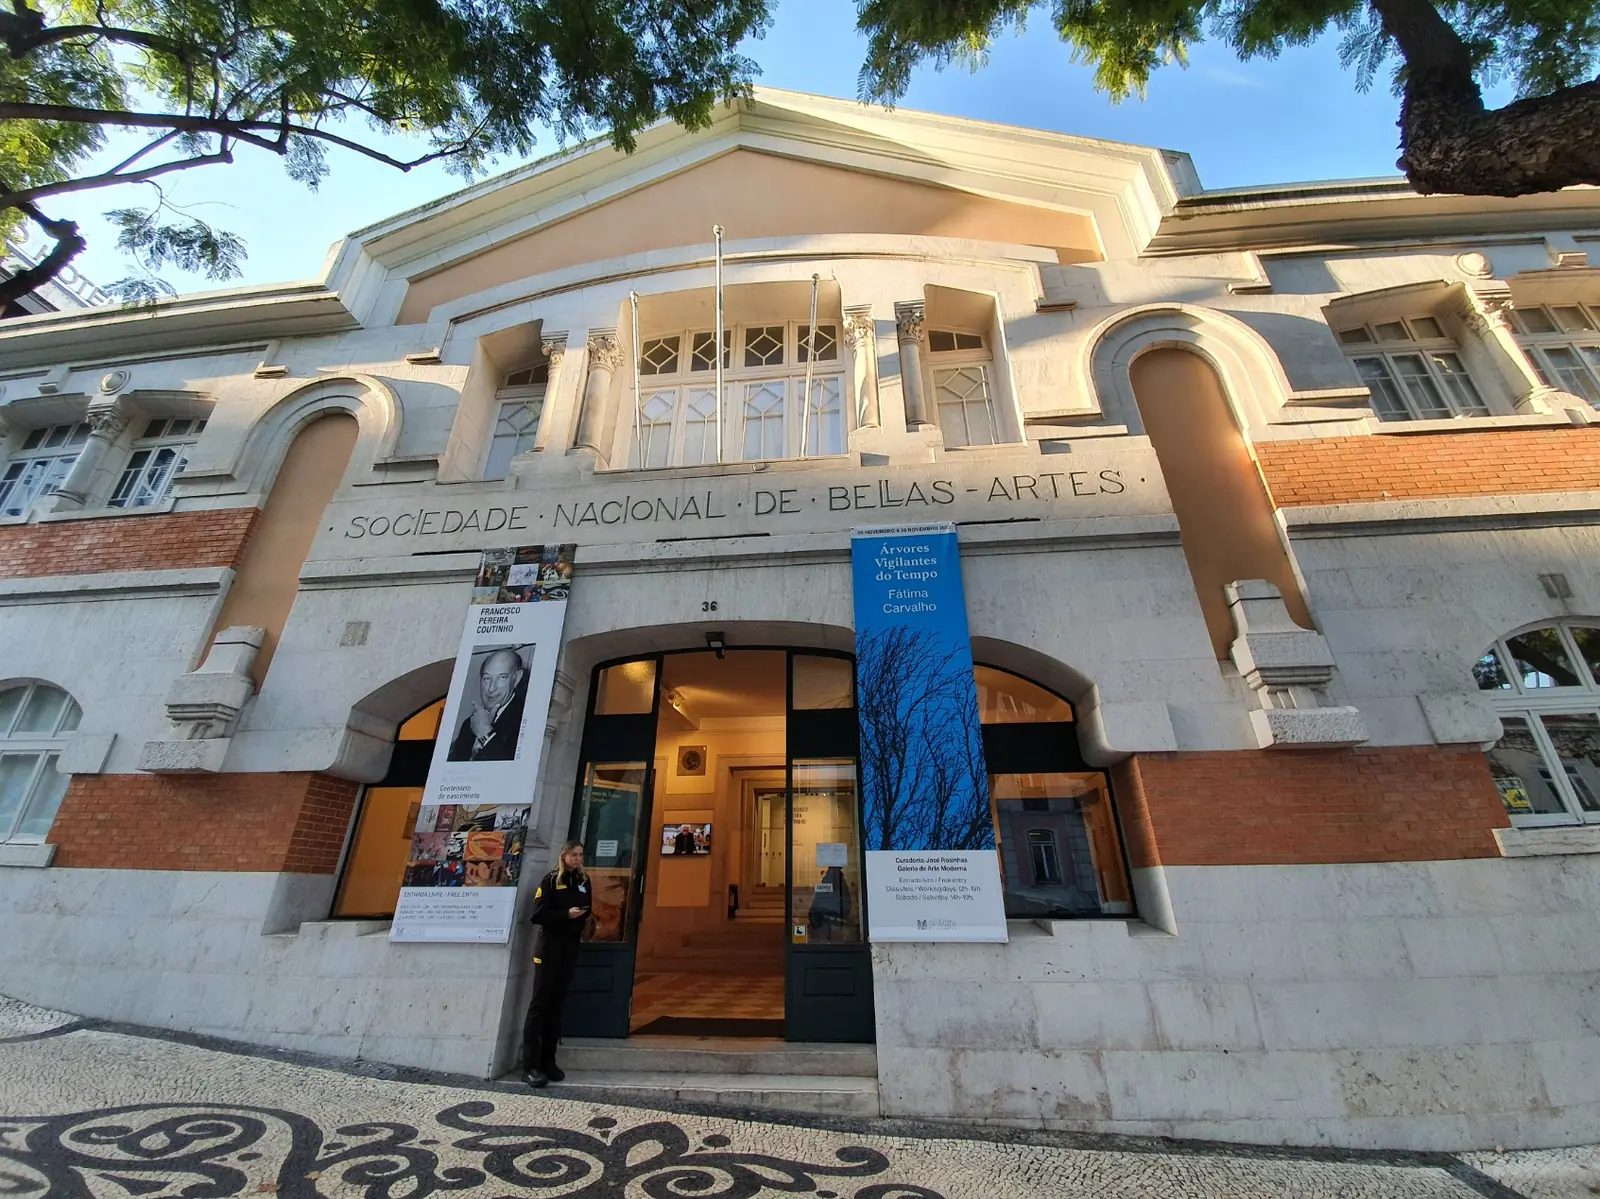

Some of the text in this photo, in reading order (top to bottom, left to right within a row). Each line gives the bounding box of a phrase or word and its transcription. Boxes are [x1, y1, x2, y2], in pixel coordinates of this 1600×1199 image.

[345, 506, 528, 539] SOCIEDADE
[554, 490, 727, 528] NACIONAL
[754, 489, 801, 516] DE
[987, 470, 1126, 502] ARTES
[880, 543, 930, 555] Árvores
[875, 557, 937, 570] Vigilantes
[876, 570, 938, 581] do Tempo
[888, 588, 929, 600] Fátima
[480, 607, 521, 615] FRANCISCO
[702, 601, 717, 612] 36
[883, 602, 937, 613] Carvalho
[478, 616, 508, 624] PEREIRA
[476, 625, 514, 634] COUTINHO
